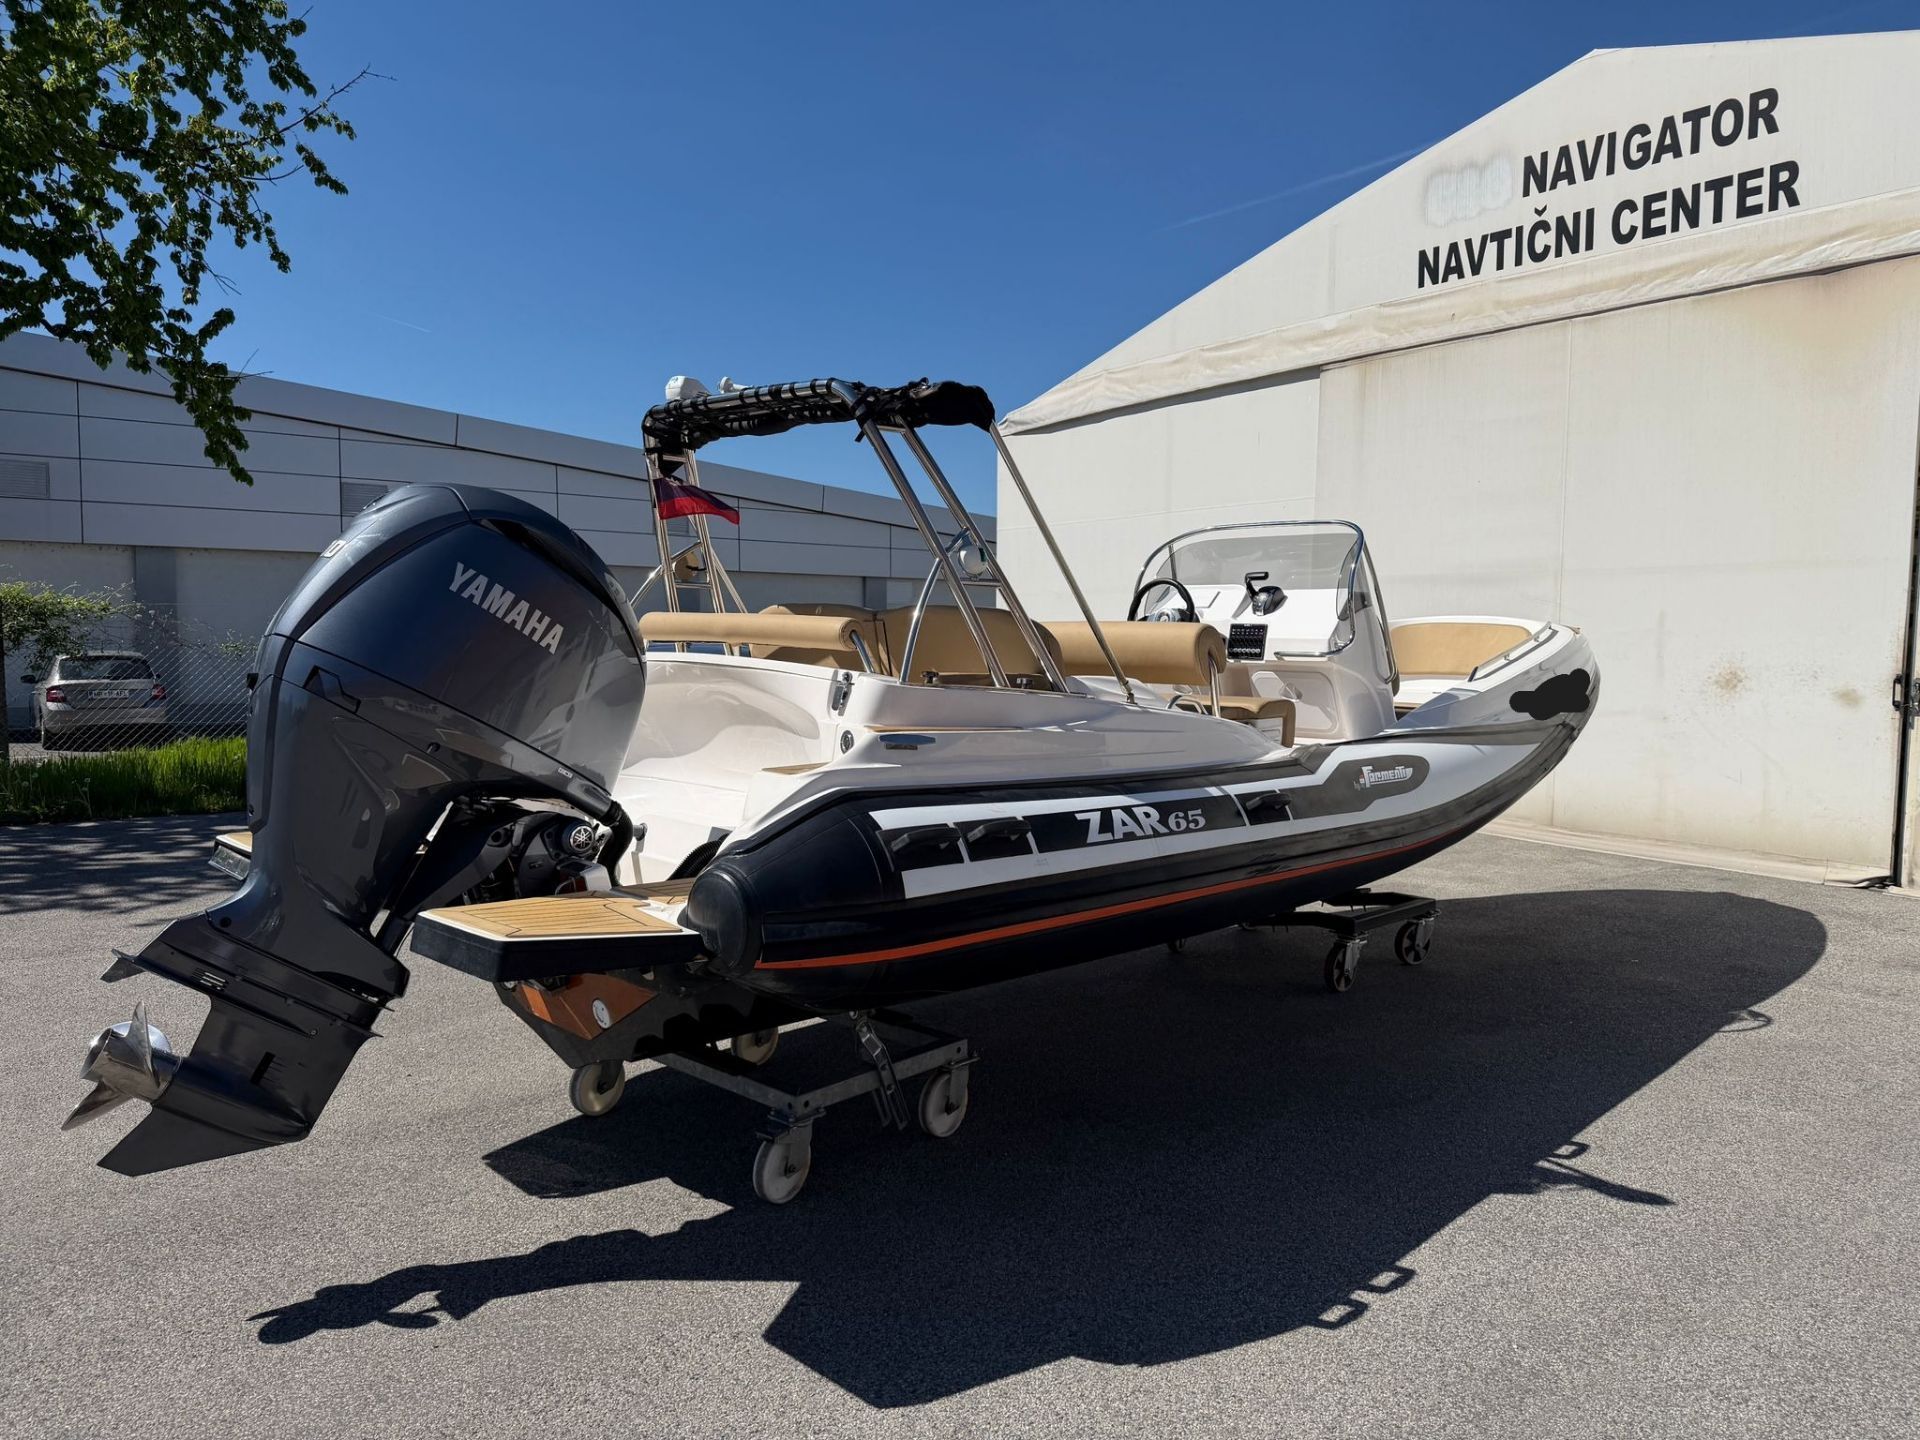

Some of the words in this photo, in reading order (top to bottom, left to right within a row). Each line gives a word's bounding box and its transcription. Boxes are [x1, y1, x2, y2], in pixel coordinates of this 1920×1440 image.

[1521, 87, 1780, 198] NAVIGATOR
[1417, 205, 1595, 289] NAVTIČNI
[1611, 160, 1801, 246] CENTER
[448, 561, 565, 655] YAMAHA
[1074, 805, 1170, 844] ZAR
[1167, 808, 1206, 832] 65
